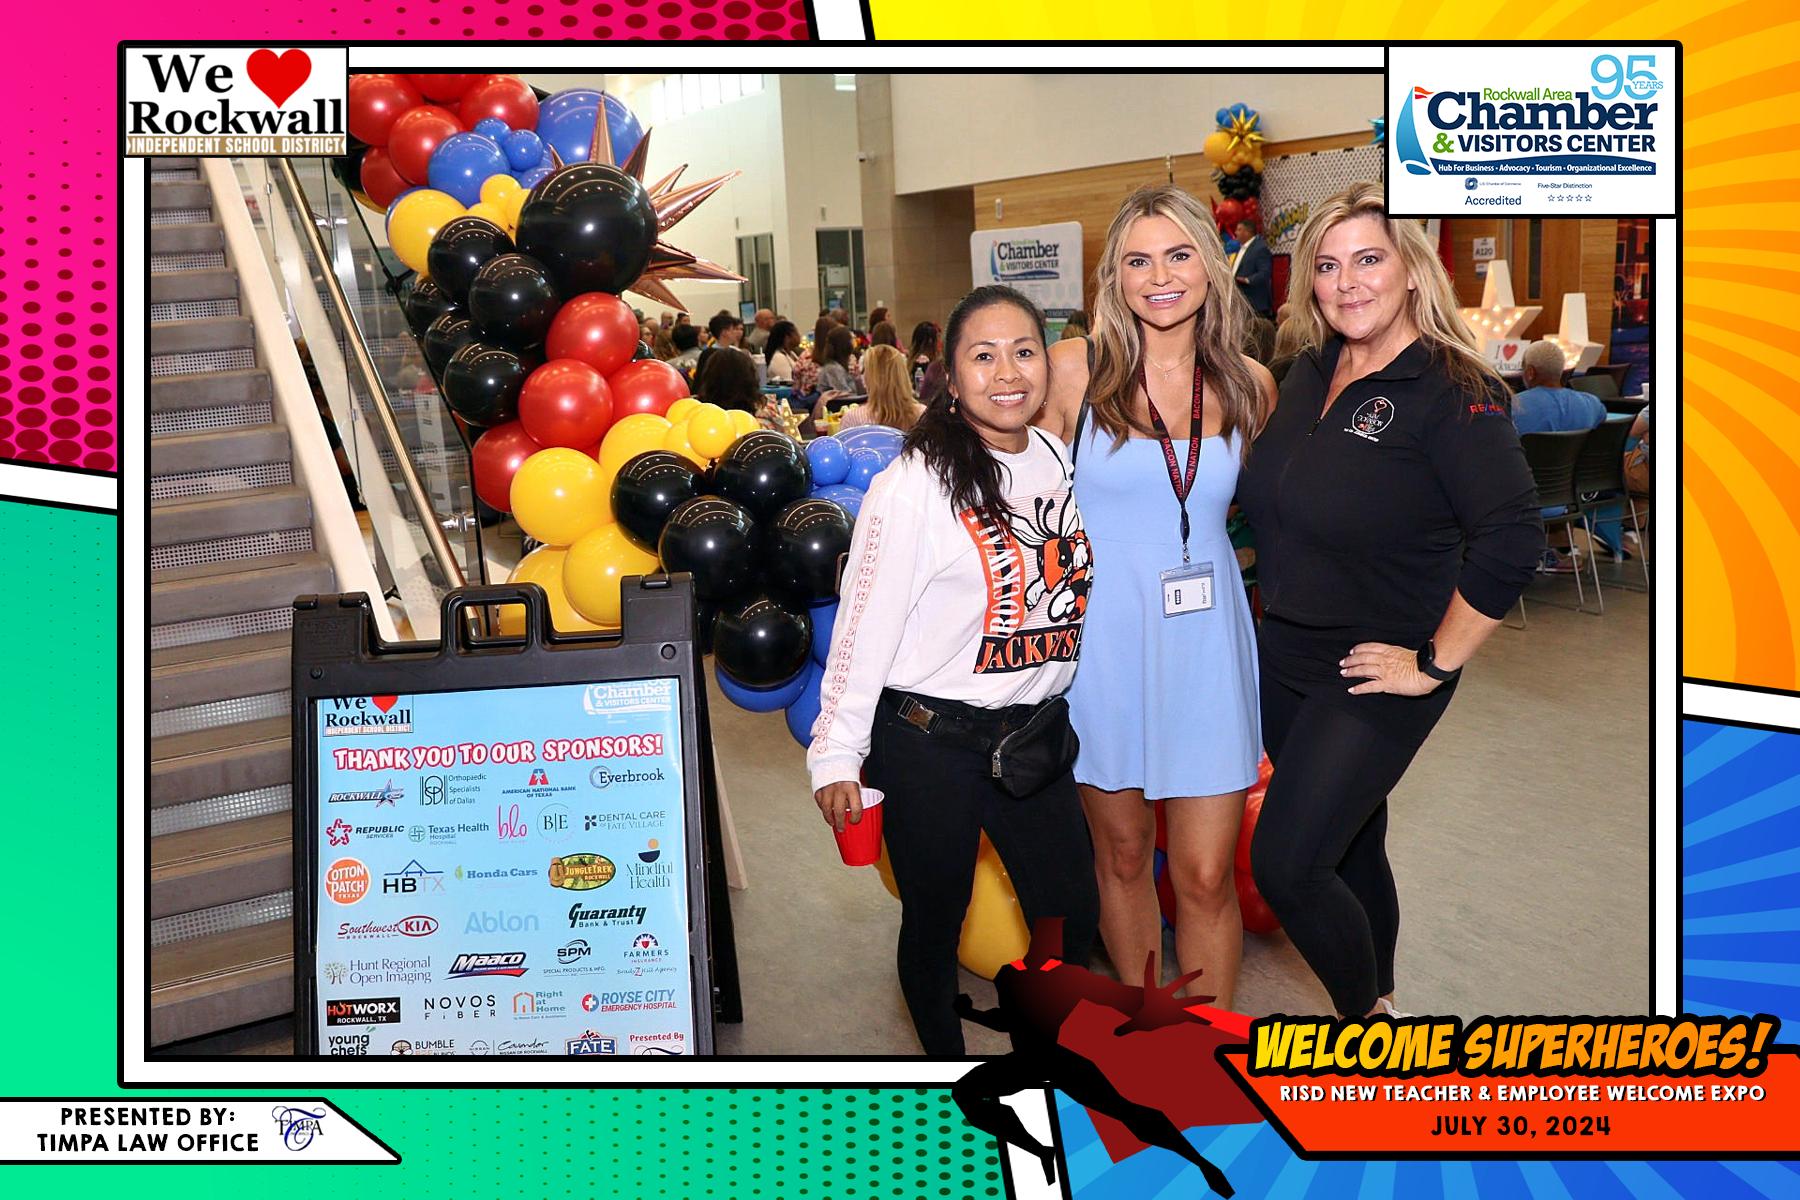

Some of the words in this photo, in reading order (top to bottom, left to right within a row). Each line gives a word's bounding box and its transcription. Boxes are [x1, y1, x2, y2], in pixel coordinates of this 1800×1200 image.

[998, 240, 1059, 260] Chamber
[1006, 260, 1033, 270] VISITORS
[1034, 259, 1058, 269] CENTER
[1189, 436, 1199, 466] NATION
[1162, 438, 1177, 467] BACON
[1170, 468, 1183, 498] NATION
[975, 629, 1077, 674] JACKETS
[593, 684, 672, 699] Chamber
[332, 697, 367, 710] We
[604, 697, 640, 706] VISITORS
[325, 709, 411, 727] Rockwall
[333, 747, 411, 771] THANK
[412, 745, 456, 769] YOU
[458, 743, 487, 765] TO
[490, 740, 535, 764] OUR
[542, 733, 663, 761] SPONSORS!
[448, 773, 487, 783] Orthopaedic
[599, 768, 665, 784] Everbrook
[330, 791, 383, 802] ROCKWALL
[448, 785, 481, 794] Specialists
[497, 803, 528, 840] blo
[599, 813, 637, 822] DENTAL
[638, 811, 666, 820] CARE
[355, 825, 405, 834] REPUBLIC
[428, 825, 455, 834] Texas
[457, 822, 489, 832] Health
[629, 819, 664, 829] VILLAGE
[429, 833, 456, 841] Hospital
[467, 868, 508, 879] Honda
[510, 867, 538, 877] Cars
[626, 861, 674, 876] Mindful
[331, 880, 364, 898] PATCH
[383, 876, 445, 894] HBTX
[629, 875, 671, 889] Health
[464, 909, 539, 934] Ablon
[568, 902, 647, 928] Guaranty
[338, 920, 399, 935] Southwest
[405, 920, 431, 932] KIA
[557, 947, 591, 956] SPM
[623, 949, 670, 958] FARMERS
[350, 959, 379, 971] Hunt
[381, 955, 431, 972] Regional
[452, 952, 524, 972] Maaco
[350, 972, 384, 987] Open
[386, 970, 432, 984] Imaging
[536, 990, 563, 998] Right
[601, 991, 642, 1004] ROYSE
[644, 988, 676, 1002] CITY
[424, 994, 496, 1010] NOVOS
[601, 1003, 643, 1012] EMERGENCY
[644, 1001, 677, 1010] HOSPITAL
[328, 1034, 370, 1048] young
[415, 1039, 455, 1049] BUMBLE
[630, 1033, 672, 1042] Presented
[673, 1032, 684, 1041] By
[331, 1045, 367, 1055] chefs
[570, 1040, 612, 1054] FATE
